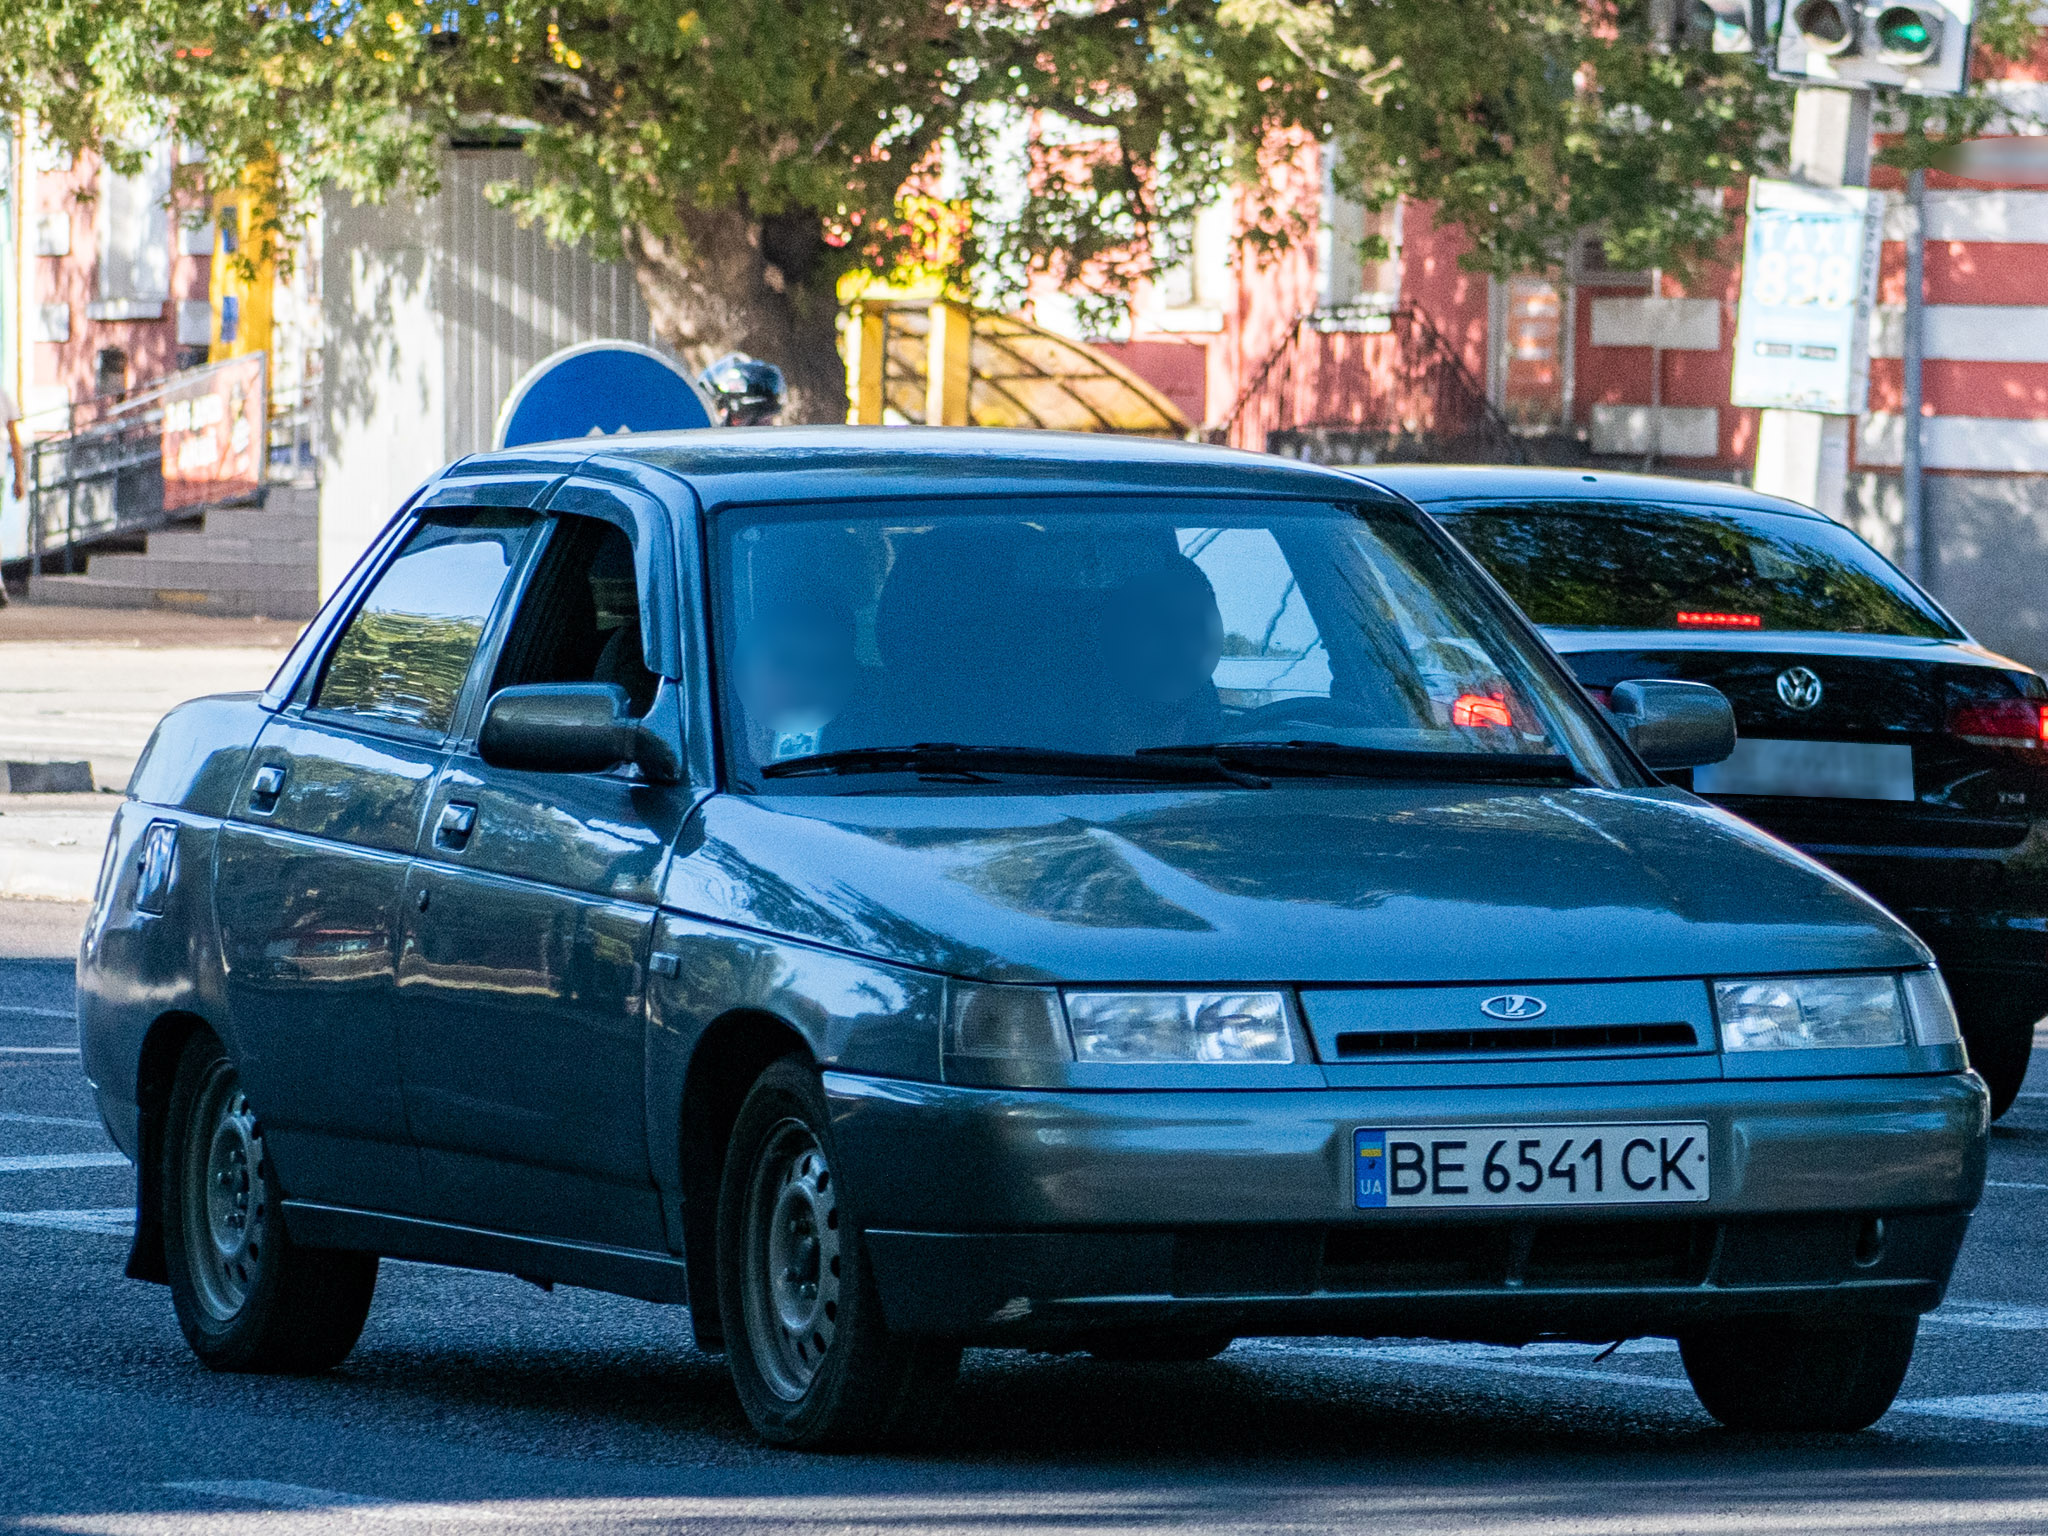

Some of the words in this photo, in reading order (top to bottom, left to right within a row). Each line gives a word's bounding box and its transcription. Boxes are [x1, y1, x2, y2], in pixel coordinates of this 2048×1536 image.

[1760, 220, 1854, 253] TAXI
[1753, 251, 1850, 311] 838
[1359, 1178, 1383, 1196] UA
[1389, 1140, 1468, 1196] BE
[1482, 1138, 1604, 1194] 6541
[1621, 1136, 1697, 1192] CK
